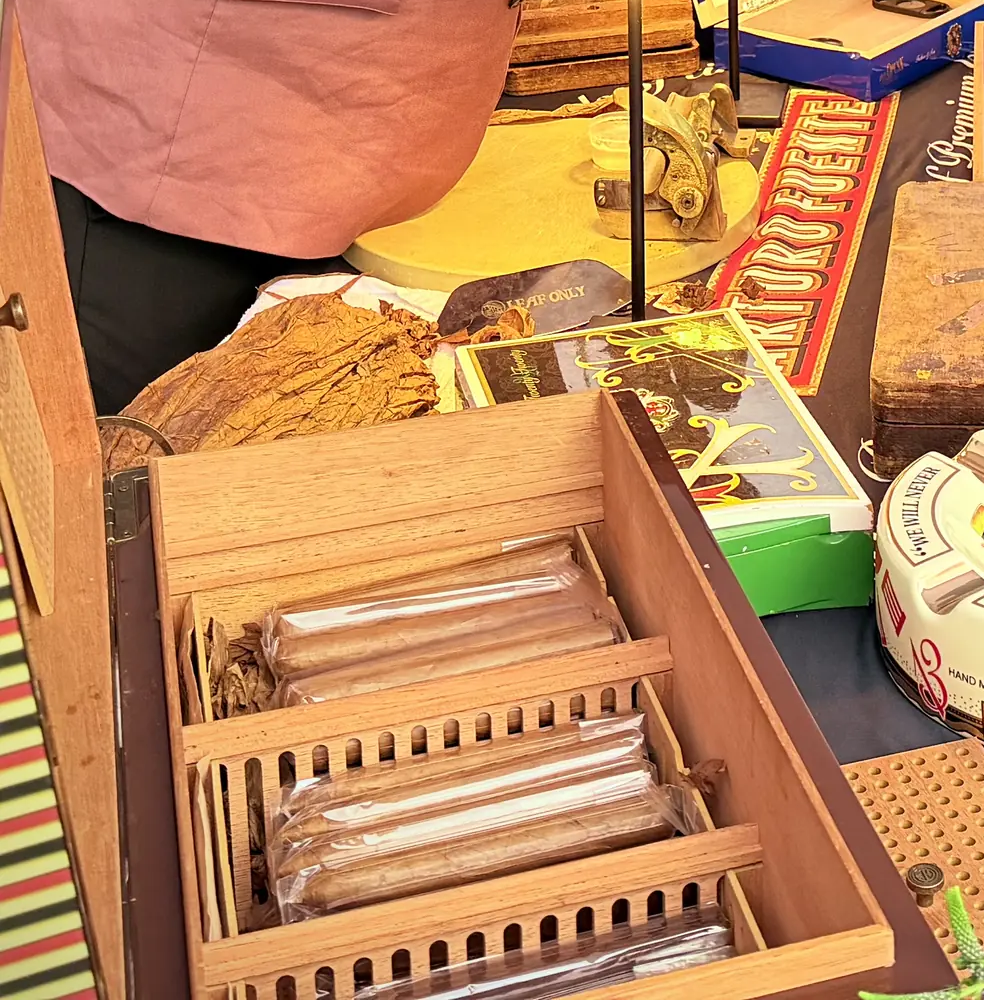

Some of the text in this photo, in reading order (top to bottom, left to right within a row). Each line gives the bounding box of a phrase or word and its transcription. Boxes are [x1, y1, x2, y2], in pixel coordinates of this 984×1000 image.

[927, 72, 974, 168] Premium
[765, 98, 880, 214] FUENTE
[548, 285, 586, 304] ONLY
[904, 466, 941, 499] NEVER
[902, 501, 921, 528] WILL
[948, 667, 977, 687] HAND
